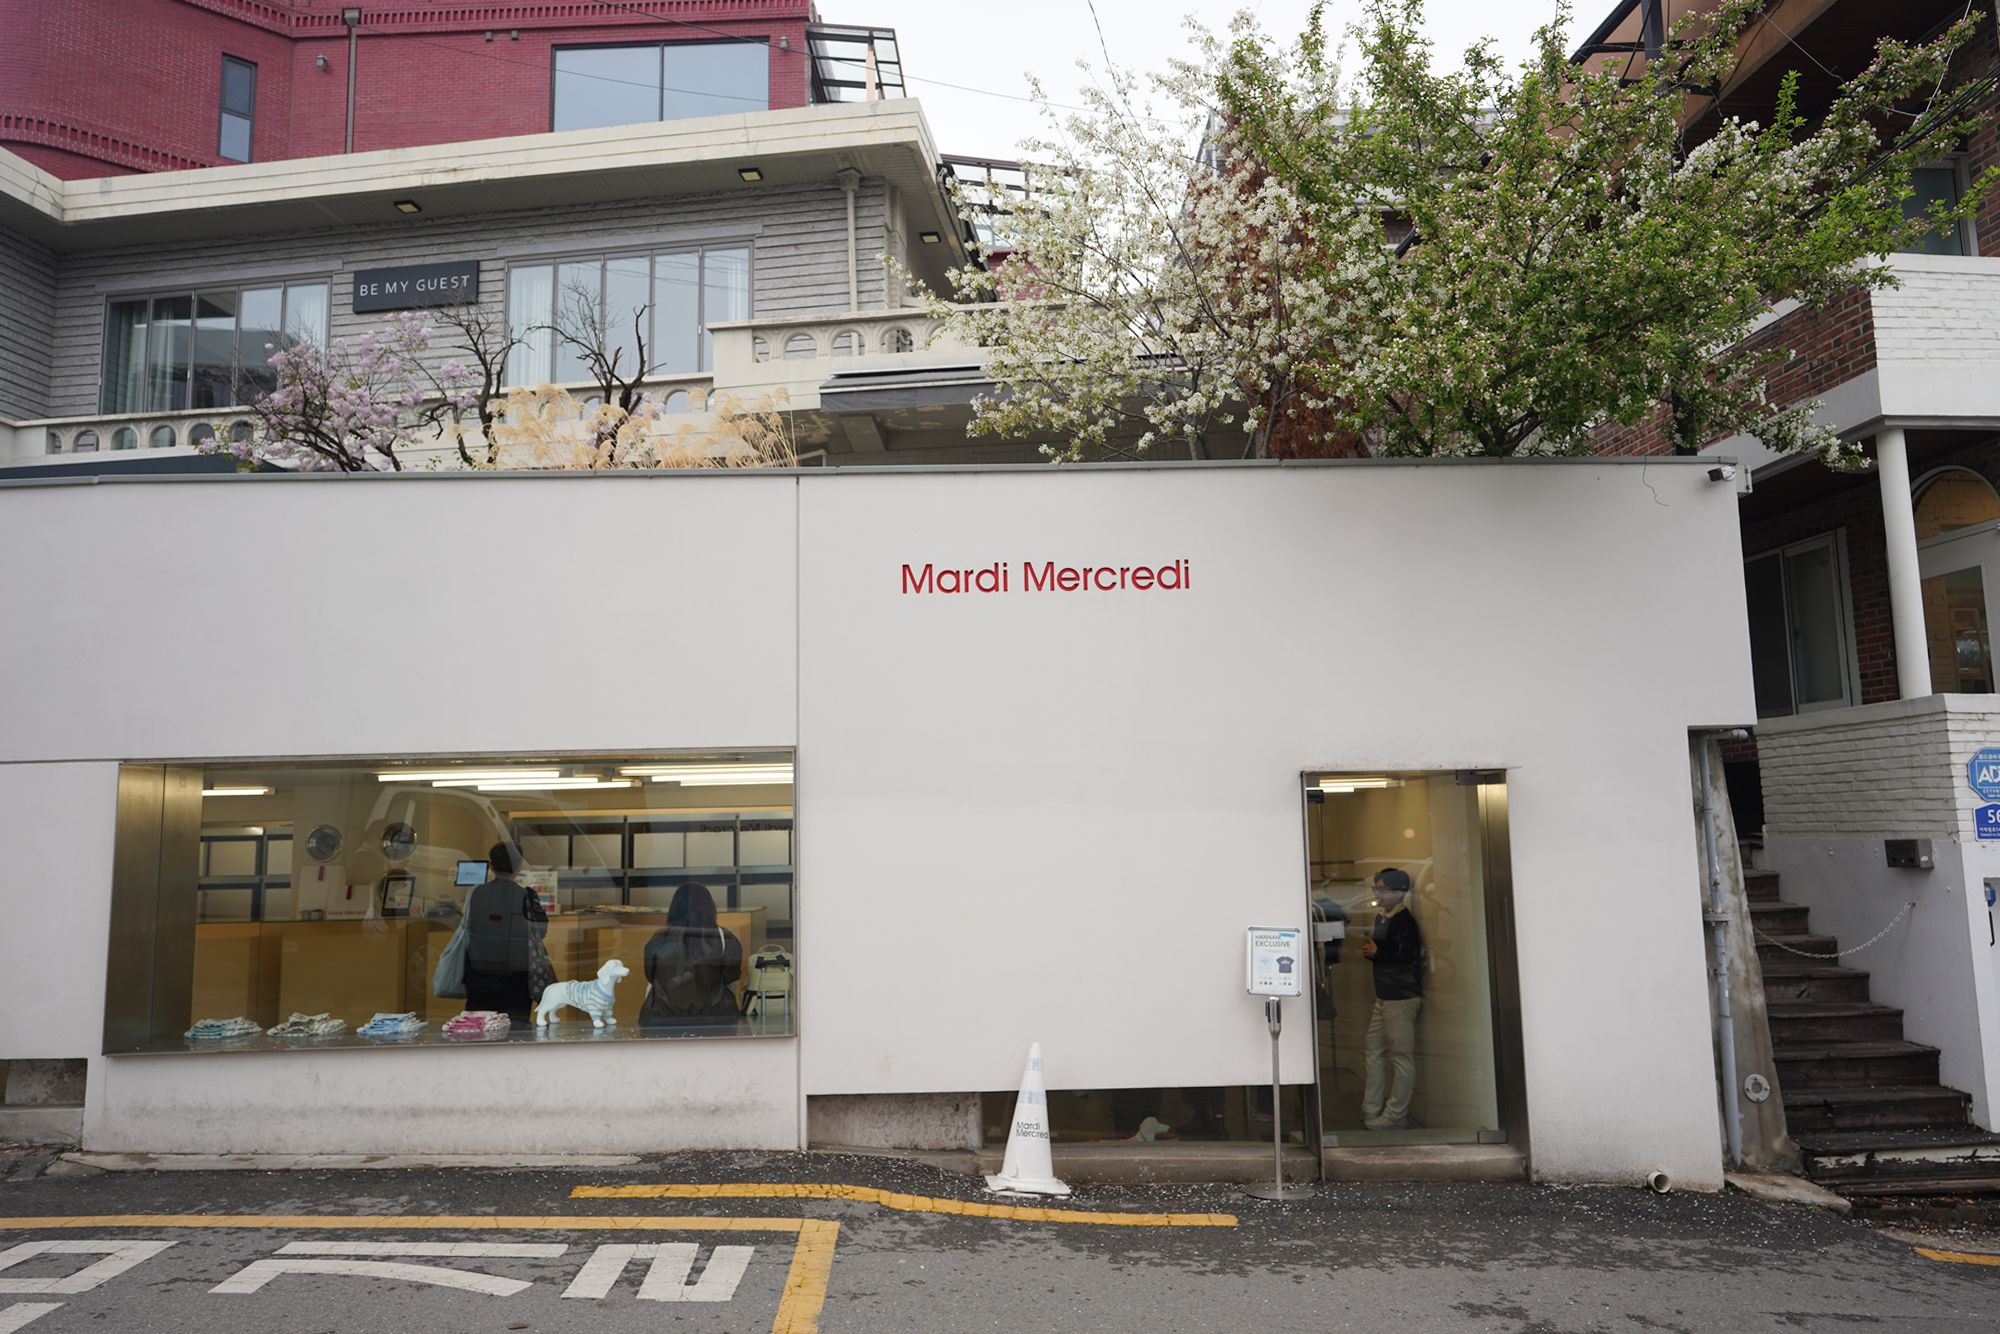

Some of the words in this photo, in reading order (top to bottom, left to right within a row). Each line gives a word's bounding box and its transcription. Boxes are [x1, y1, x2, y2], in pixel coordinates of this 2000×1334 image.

[360, 284, 379, 297] BE
[385, 281, 409, 294] MY
[416, 275, 470, 292] GUEST
[902, 562, 1008, 594] Mardi
[1023, 559, 1190, 592] Mercredi
[1255, 940, 1291, 948] EXCLUSIVE
[1016, 1121, 1040, 1130] Mardi
